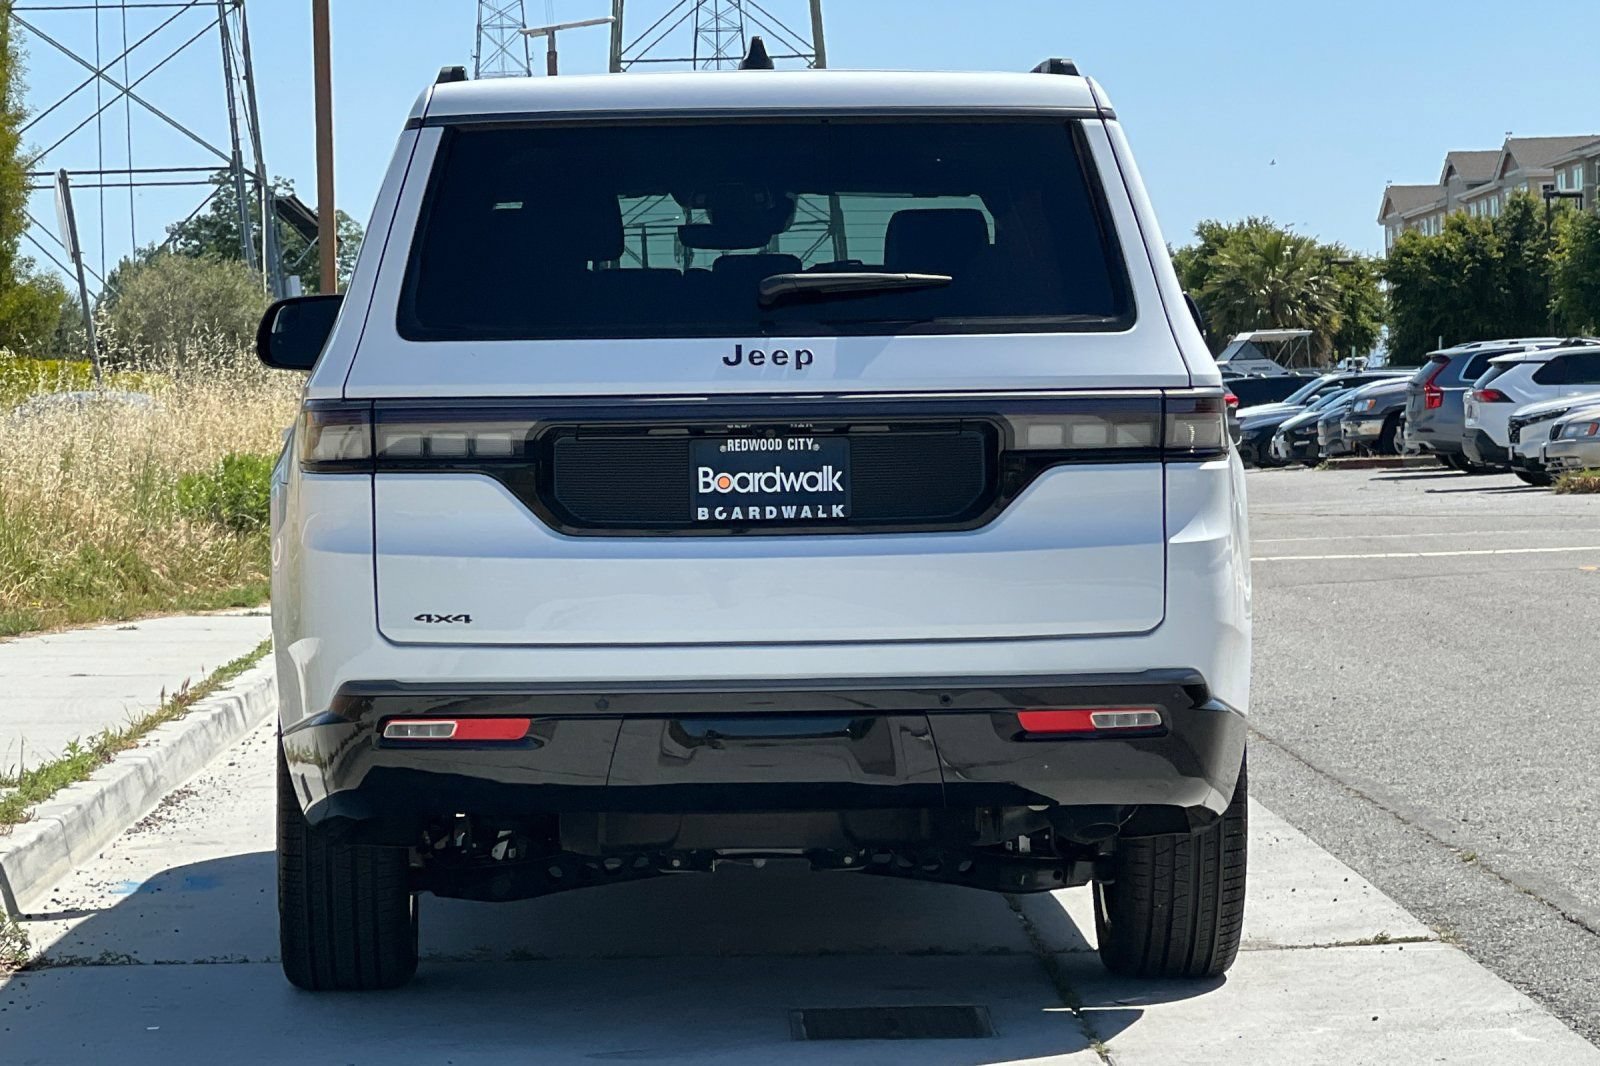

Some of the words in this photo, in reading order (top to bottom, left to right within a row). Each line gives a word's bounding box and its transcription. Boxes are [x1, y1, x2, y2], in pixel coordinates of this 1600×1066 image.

[722, 344, 814, 370] Jeep
[727, 438, 783, 452] REDWOOD
[787, 437, 814, 451] CITY
[697, 465, 844, 493] Boardwalk
[697, 504, 845, 521] BOARDWALK
